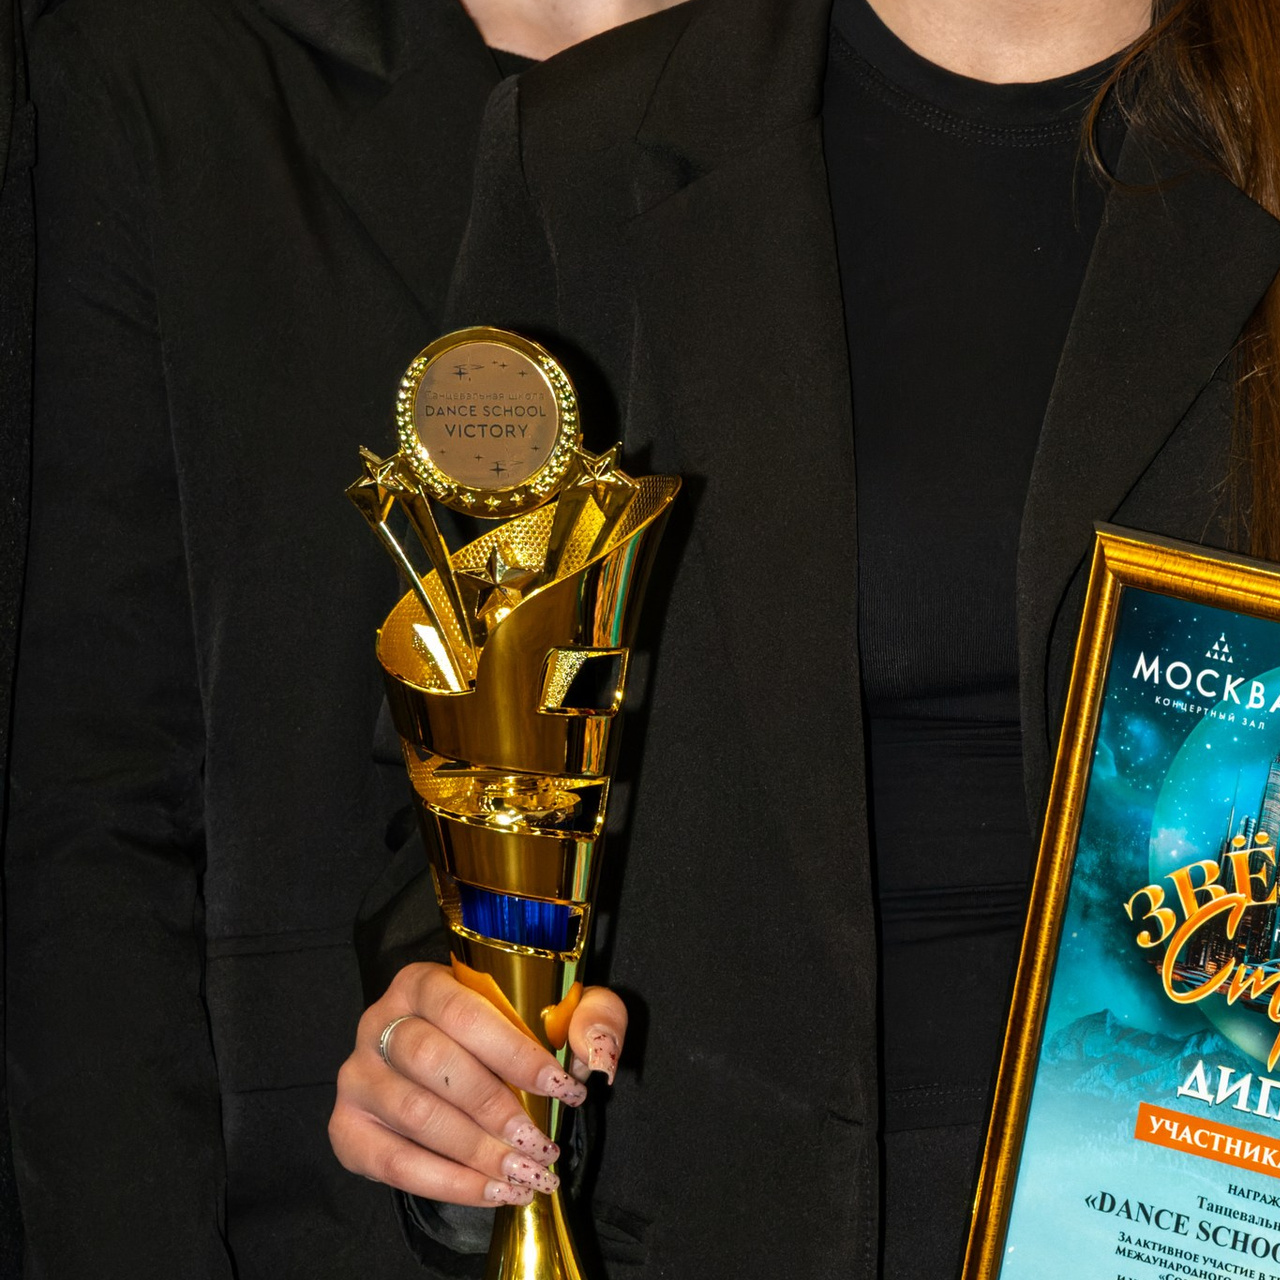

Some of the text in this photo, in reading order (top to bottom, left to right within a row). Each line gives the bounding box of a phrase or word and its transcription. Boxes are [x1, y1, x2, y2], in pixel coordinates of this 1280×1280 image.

[425, 405, 546, 417] DANCE SCHOOL
[445, 424, 528, 438] VICTORY
[1155, 695, 1265, 730] КОНЦЕРТНЫЙ ЗАЛ
[1084, 1191, 1190, 1237] «DANCE
[1118, 1231, 1132, 1245] ЗА
[1135, 1238, 1200, 1263] АКТИВНОЕ
[1202, 1256, 1255, 1279] УЧАСТИЕ
